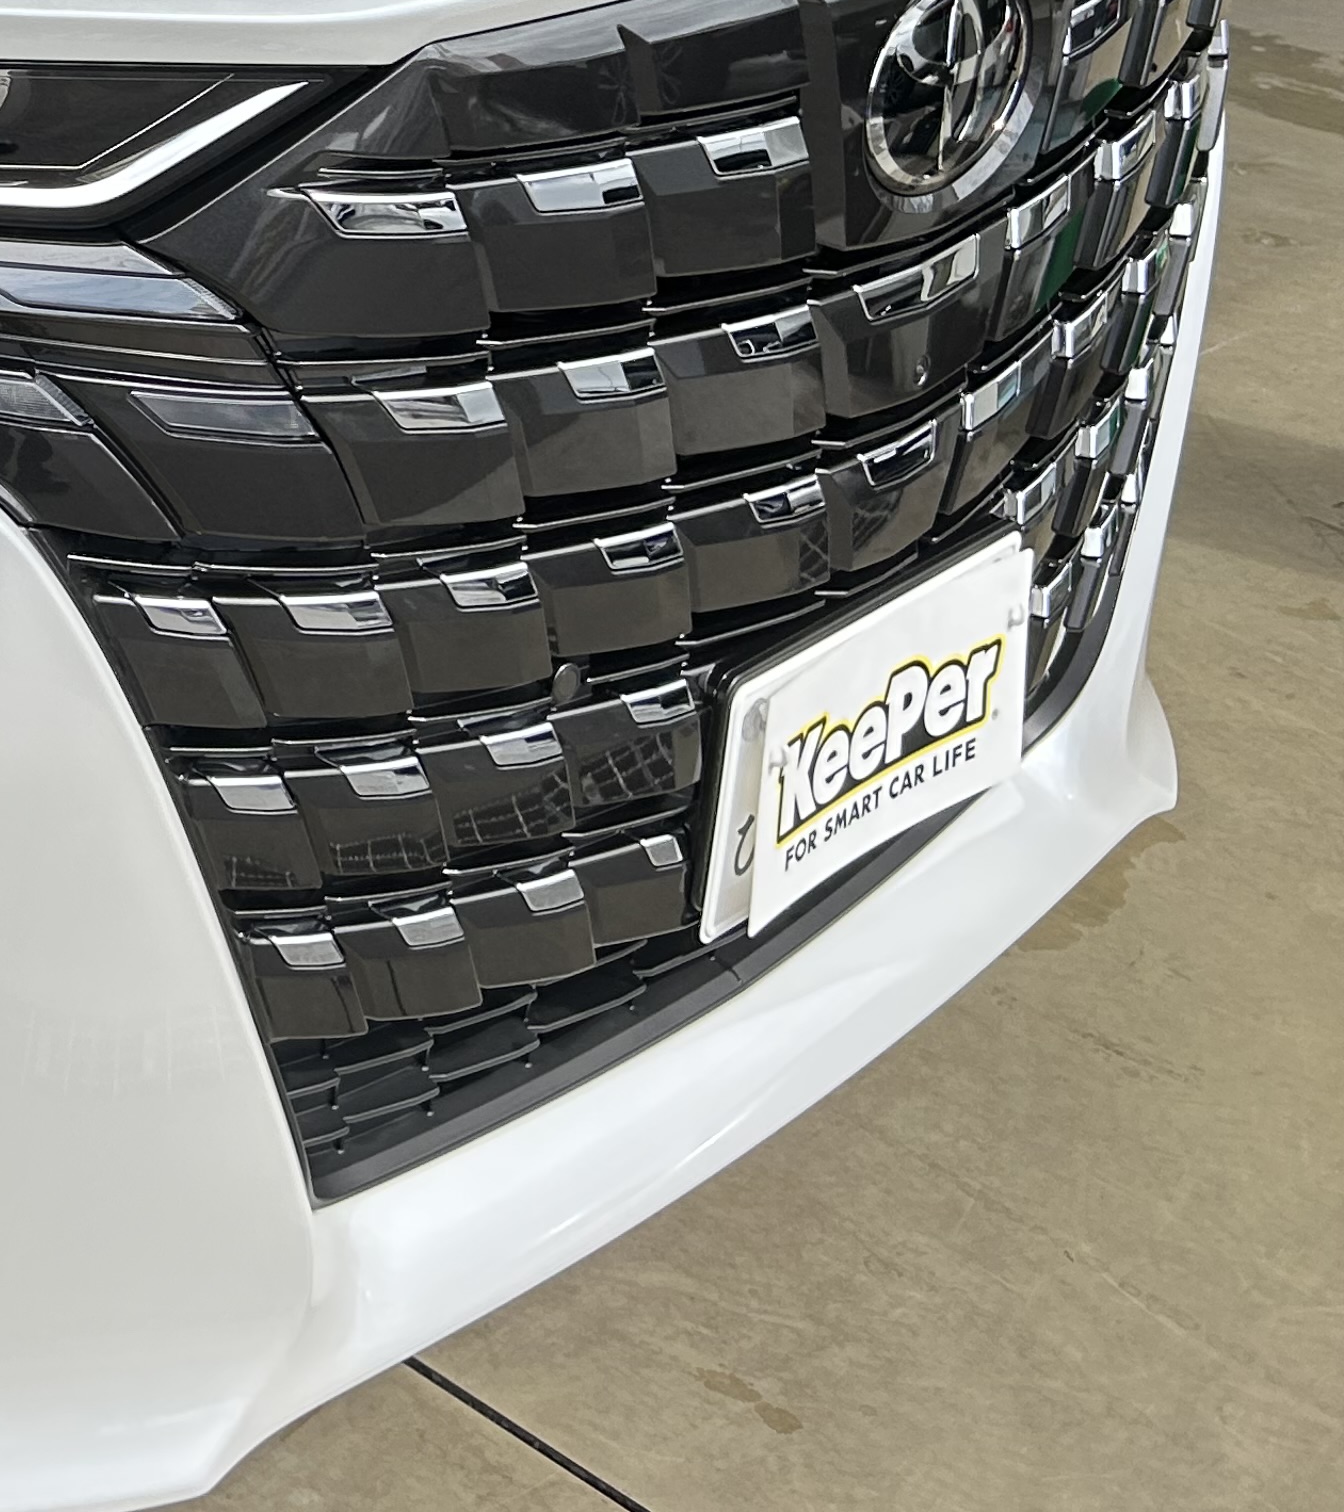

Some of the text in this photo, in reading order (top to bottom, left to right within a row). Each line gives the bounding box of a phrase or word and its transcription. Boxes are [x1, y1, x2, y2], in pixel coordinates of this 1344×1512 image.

[776, 638, 1003, 846] KeePer
[784, 737, 977, 872] FOR SMART CAR LIFE
